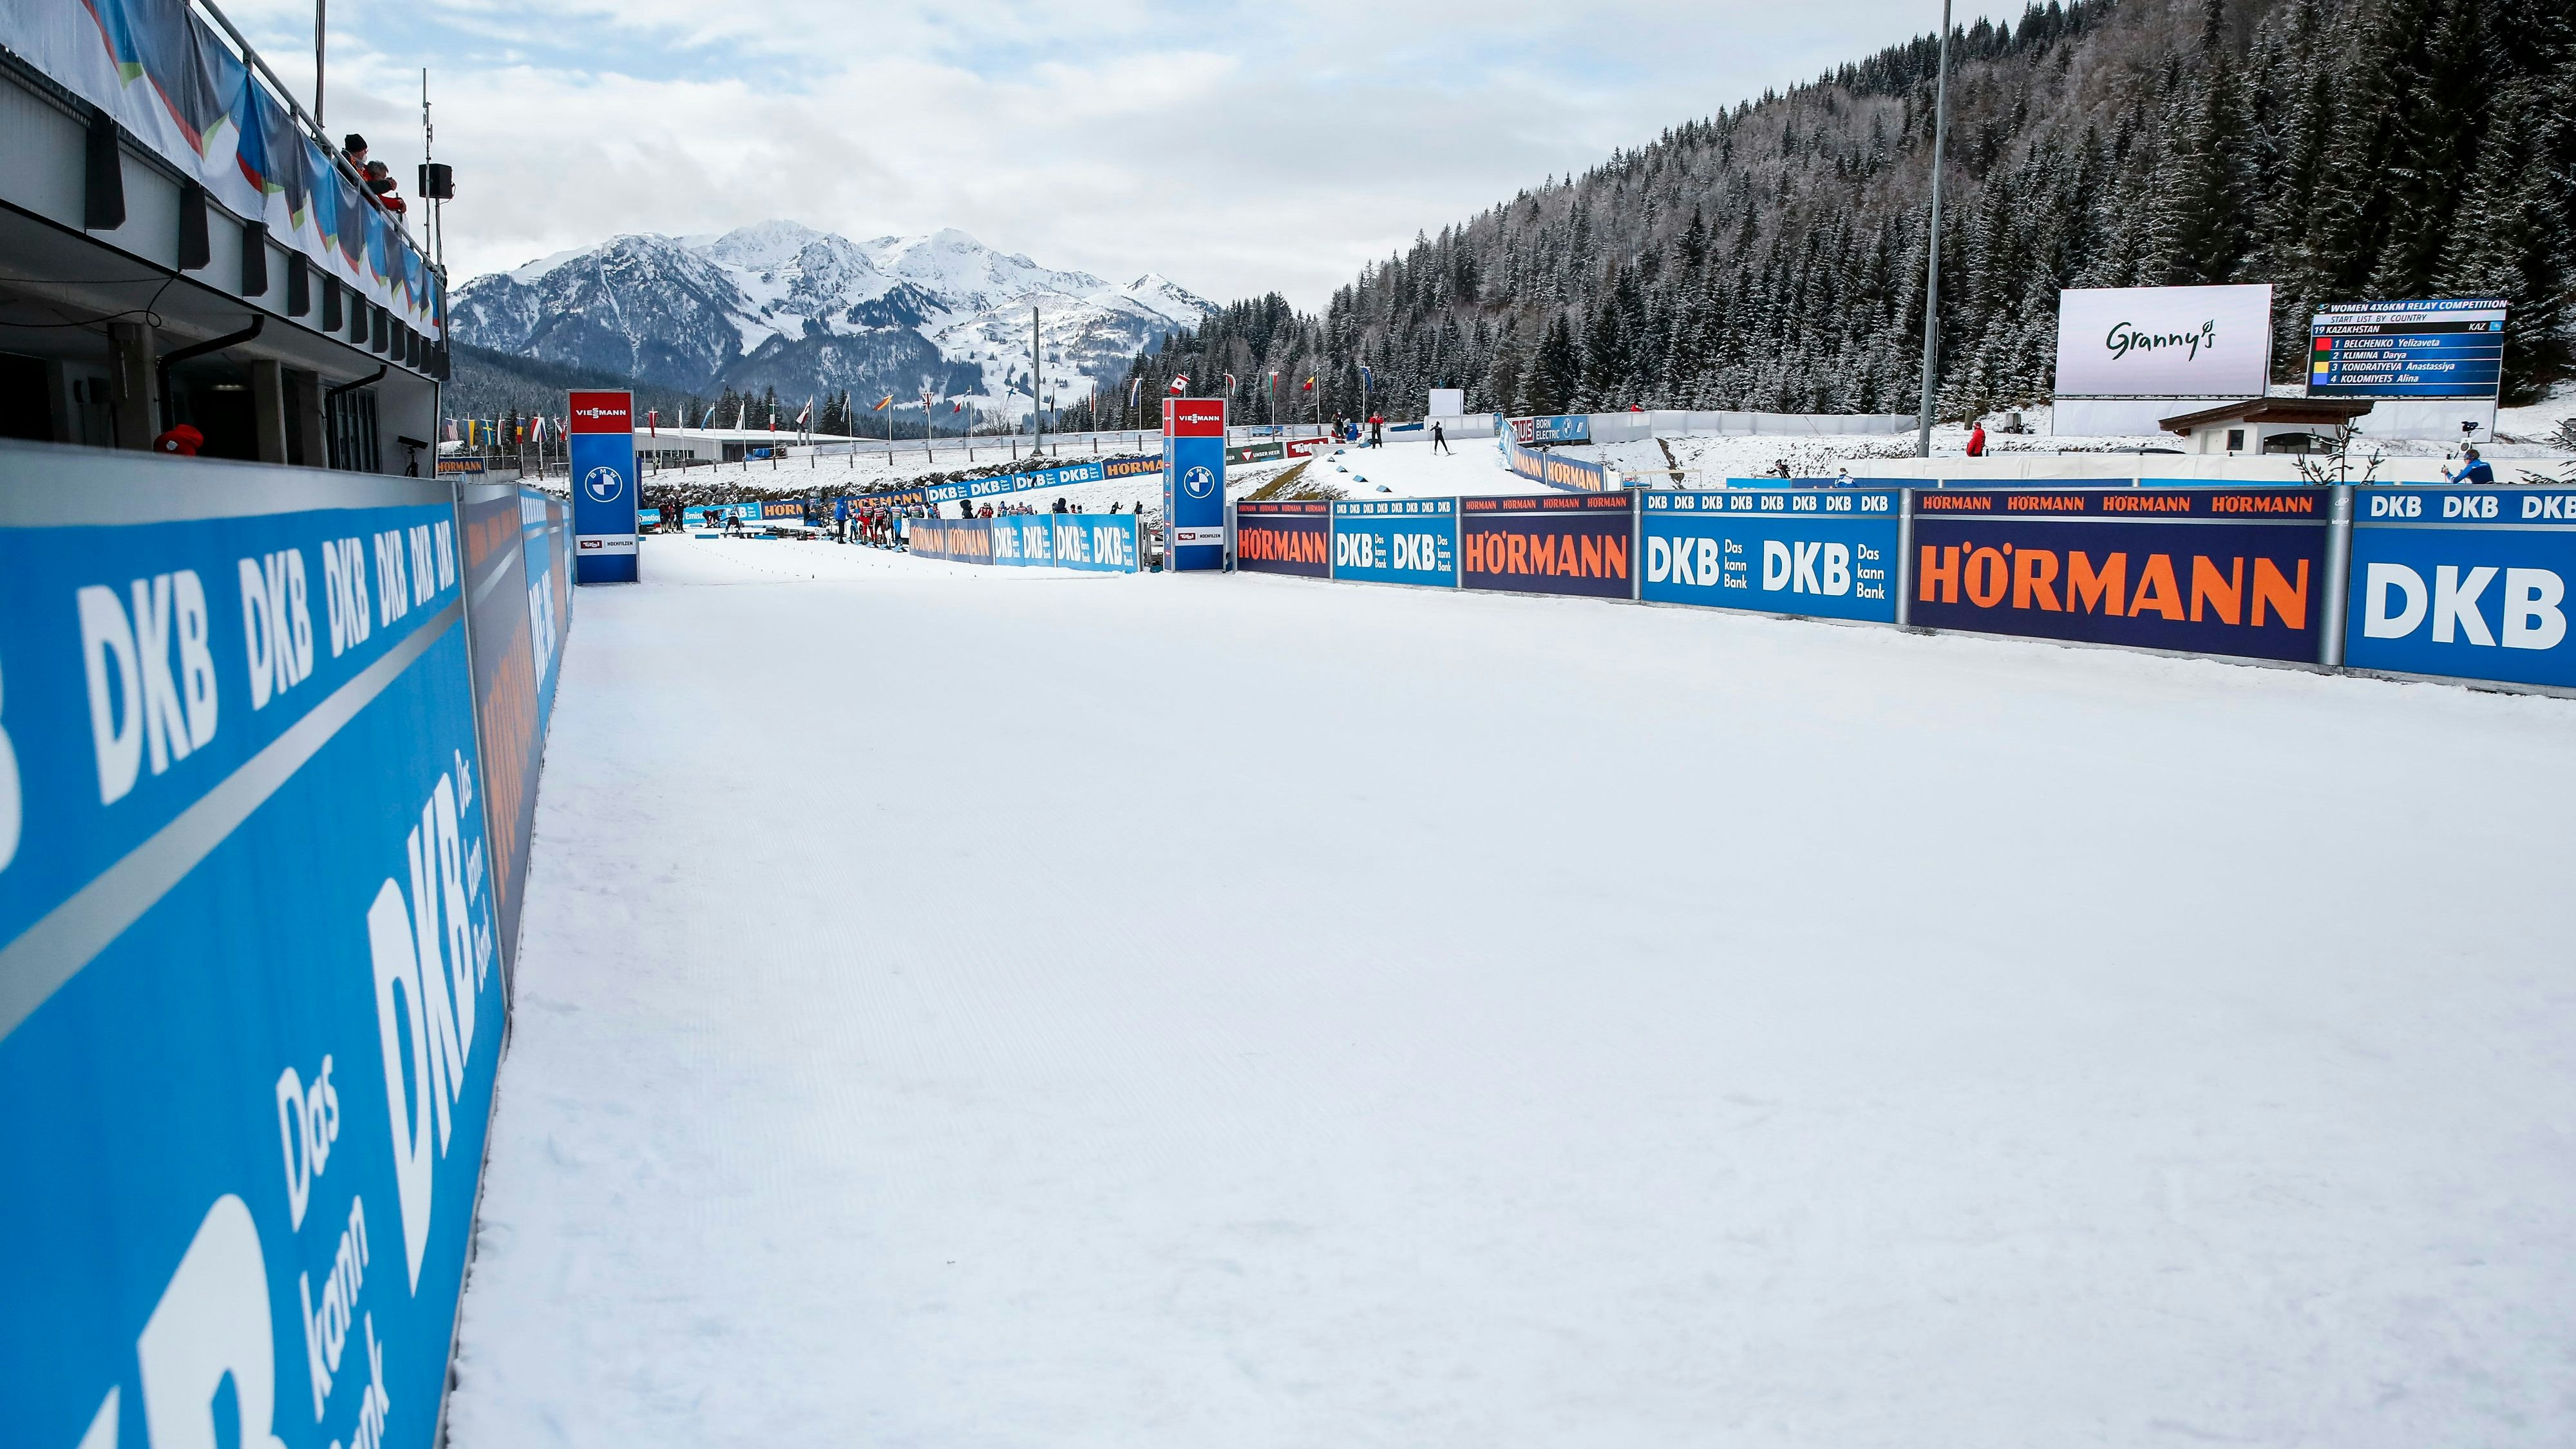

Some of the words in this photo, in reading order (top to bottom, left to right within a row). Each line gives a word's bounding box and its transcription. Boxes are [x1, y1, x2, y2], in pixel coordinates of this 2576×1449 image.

[2331, 304, 2368, 312] WOMEN
[2369, 303, 2405, 312] 4X6KM
[2407, 302, 2438, 310] RELAY
[2439, 299, 2508, 310] COMPETITION
[2331, 315, 2352, 323] START
[2325, 325, 2380, 334] KAZAKHSTAN
[2468, 323, 2485, 331] KAZ
[2106, 319, 2215, 361] Granny's
[2344, 339, 2394, 348] BELCHENKO
[2398, 339, 2439, 347] Yelizaveta
[2382, 352, 2407, 361] Darya
[2341, 363, 2401, 372] KONDRATYEVA
[2405, 362, 2455, 372] Anastassiya
[2340, 375, 2392, 383] KOLOMIYETS
[2396, 374, 2419, 383] Alina
[576, 408, 627, 419] VIESSMANN
[1179, 413, 1220, 424] VIESSMANN
[1536, 419, 1551, 428] BORN
[1536, 429, 1560, 440] ELECTRIC
[590, 468, 617, 479] BMW
[1059, 468, 1089, 483] DKB
[1188, 468, 1211, 477] BMW
[929, 487, 958, 502] DKB
[971, 480, 1000, 496] DKB
[1337, 504, 1347, 514] DKB
[1349, 504, 1360, 514] DKB
[1363, 504, 1374, 514] DKB
[1377, 503, 1388, 513] DKB
[1391, 503, 1403, 513] DKB
[1406, 502, 1418, 513] DKB
[1421, 502, 1434, 513] DKB
[1437, 502, 1450, 513] DKB
[1466, 500, 1497, 509] HÖRMANN
[1503, 499, 1536, 509] HÖRMANN
[1544, 498, 1579, 508] HÖRMANN
[1587, 497, 1627, 507] HÖRMANN
[1648, 495, 1668, 509] DKB
[1674, 495, 1694, 509] DKB
[1701, 495, 1723, 509] DKB
[1730, 495, 1753, 510] DKB
[1761, 495, 1784, 511] DKB
[1792, 495, 1817, 511] DKB
[1826, 495, 1852, 511] DKB
[1861, 496, 1888, 511] DKB
[1923, 496, 1991, 511] HÖRMANN
[2008, 496, 2084, 511] HÖRMANN
[2103, 495, 2190, 513] HÖRMANN
[2212, 495, 2313, 513] HÖRMANN
[2371, 496, 2422, 517] DKB
[2443, 496, 2499, 518] DKB
[2521, 496, 2576, 518] DKB
[725, 506, 747, 518] DB
[947, 527, 990, 556] HÖRMANN
[994, 527, 1013, 558] DKB
[1023, 526, 1043, 559] DKB
[1056, 525, 1081, 562] DKB
[1094, 527, 1122, 565] DKB
[1238, 527, 1327, 564] HÖRMANN
[1374, 533, 1384, 544] Das
[1437, 534, 1448, 545] Das
[1725, 538, 1743, 554] Das
[1337, 533, 1373, 567] DKB
[1393, 533, 1435, 571] DKB
[1437, 547, 1451, 559] kann
[1466, 530, 1627, 579] HÖRMANN
[1857, 544, 1879, 560] Das
[1374, 558, 1387, 569] Bank
[1437, 560, 1452, 572] Bank
[1647, 536, 1719, 587] DKB
[1724, 556, 1747, 572] kann
[1763, 540, 1851, 596] DKB
[1857, 563, 1884, 580] kann
[1724, 574, 1748, 589] Bank
[1919, 541, 2309, 630] HÖRMANN
[1857, 582, 1885, 600] Bank
[2363, 562, 2567, 650] DKB
[77, 569, 218, 807] DKB
[238, 548, 314, 712] DKB
[323, 537, 370, 658] DKB
[374, 529, 408, 629] DKB
[409, 525, 435, 607] DKB
[434, 520, 455, 591] DKB
[367, 772, 476, 1299] DKB
[276, 1054, 339, 1234] Das
[299, 1195, 369, 1424] kann
